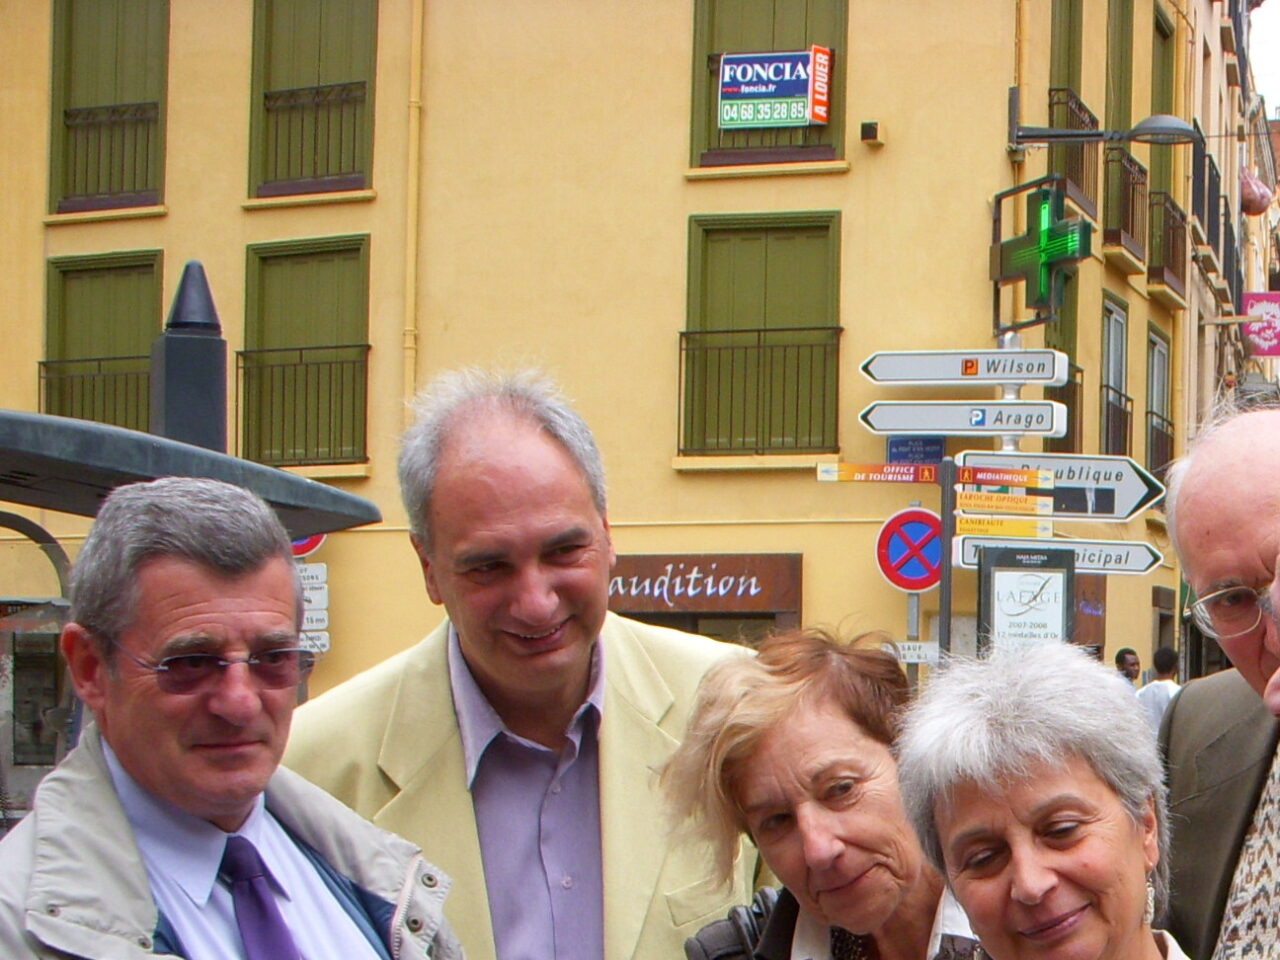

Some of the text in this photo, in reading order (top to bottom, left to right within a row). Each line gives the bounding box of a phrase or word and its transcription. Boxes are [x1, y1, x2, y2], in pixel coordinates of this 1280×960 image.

[723, 61, 808, 83] FONCIA
[814, 53, 829, 117] A LOUER
[723, 102, 804, 120] 04 68 35 28 85
[986, 359, 1046, 374] Wilson
[993, 410, 1045, 429] Arago
[854, 472, 915, 482] DE TOURISME
[883, 465, 915, 474] OFFICE
[975, 471, 1029, 482] MEDIATHEQUE
[995, 494, 1029, 505] OPTIQUE
[608, 562, 762, 608] audition
